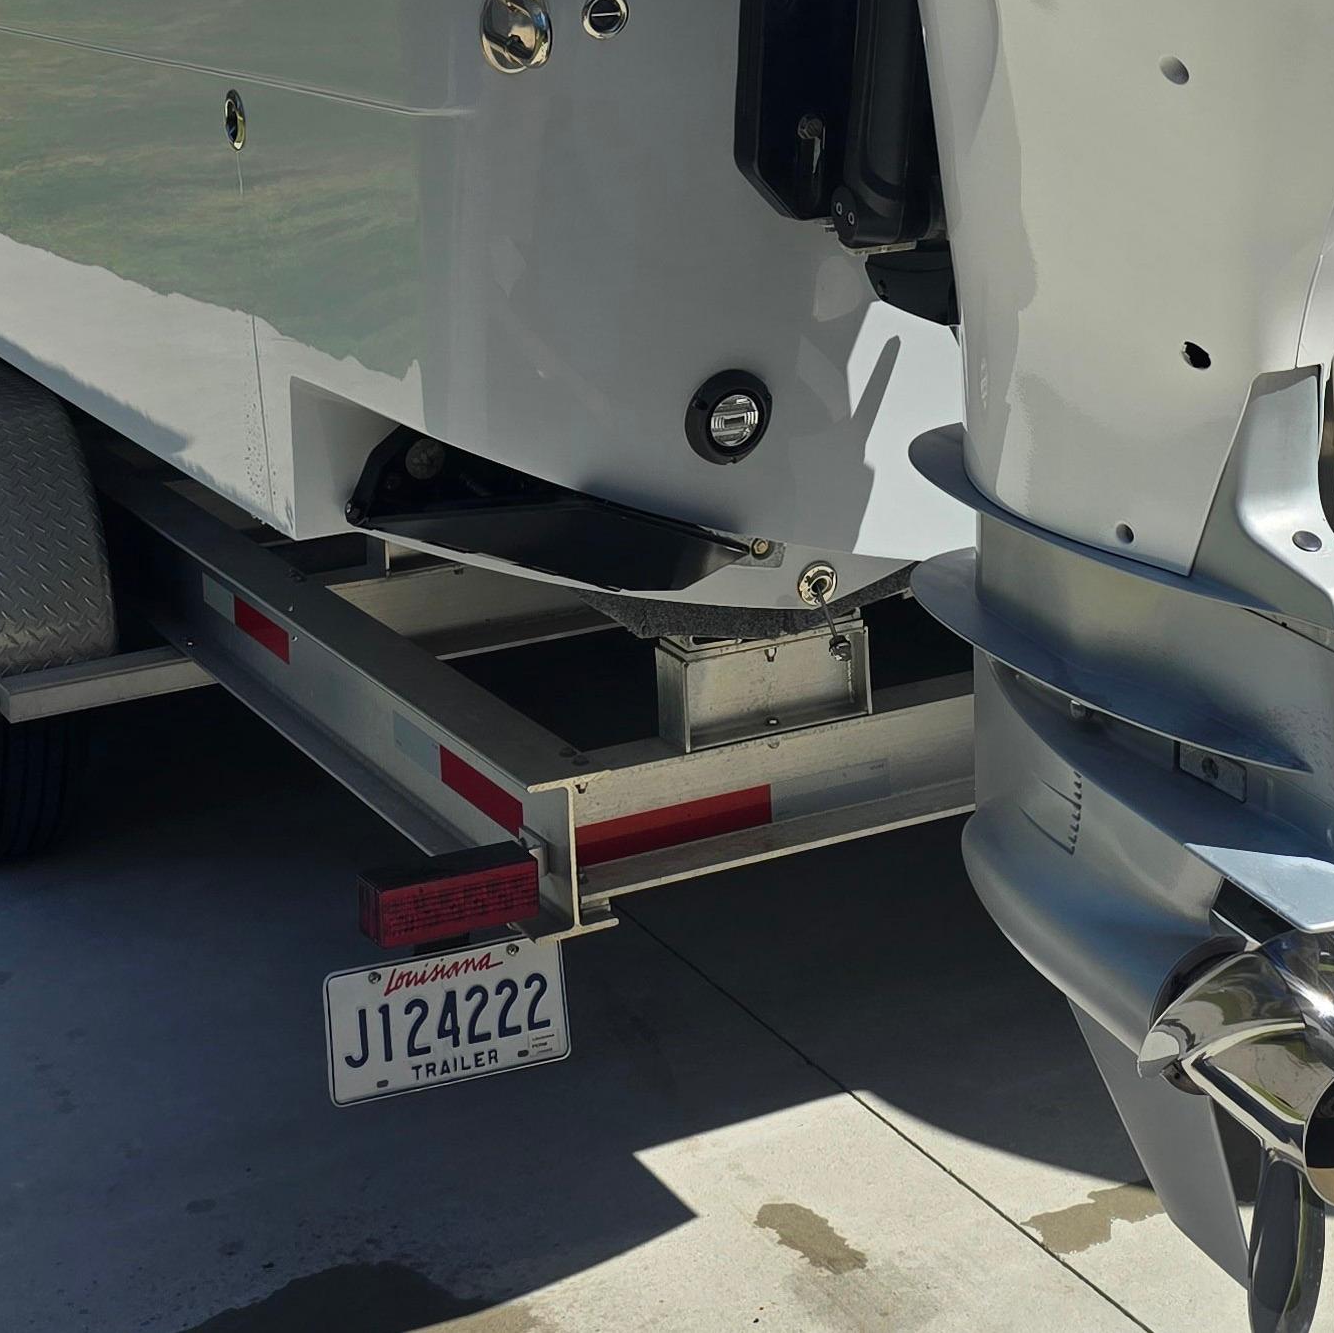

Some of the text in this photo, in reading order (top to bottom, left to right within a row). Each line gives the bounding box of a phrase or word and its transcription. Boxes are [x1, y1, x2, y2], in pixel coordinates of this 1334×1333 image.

[383, 952, 504, 997] Louisiana
[344, 972, 552, 1070] J124222
[411, 1049, 500, 1082] TRAILER
